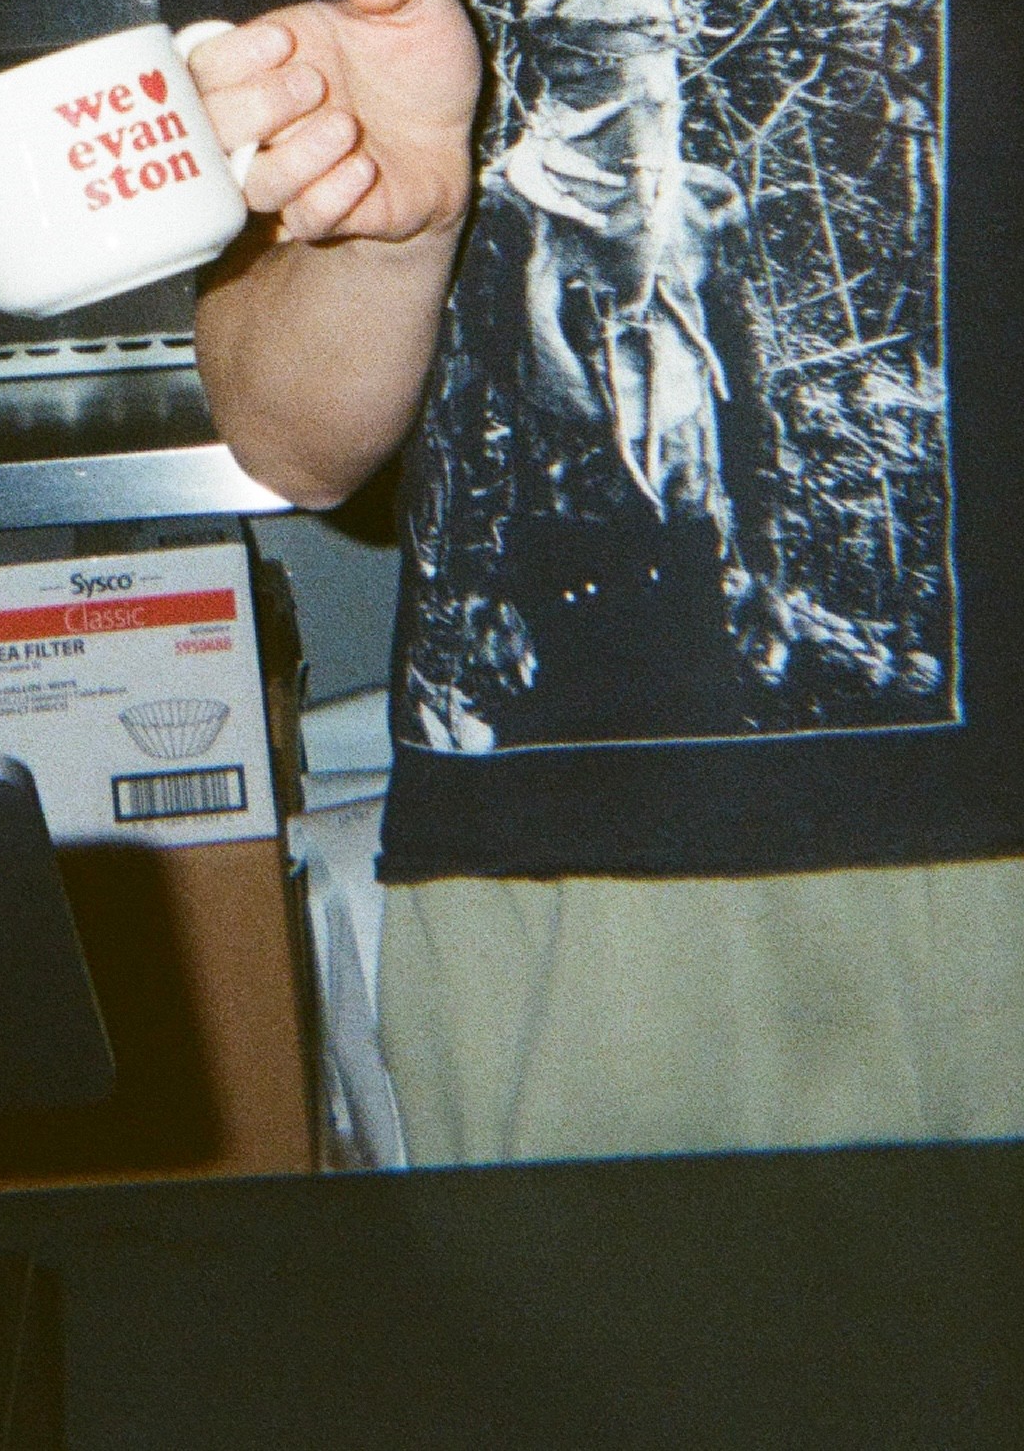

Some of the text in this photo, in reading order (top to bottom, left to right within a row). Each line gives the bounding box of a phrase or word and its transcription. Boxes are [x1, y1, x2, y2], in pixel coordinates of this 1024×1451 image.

[54, 84, 135, 128] we
[67, 110, 189, 171] evan
[84, 149, 202, 211] ston
[70, 572, 132, 597] Sysco
[64, 603, 145, 634] Classic
[24, 638, 85, 659] FILTER
